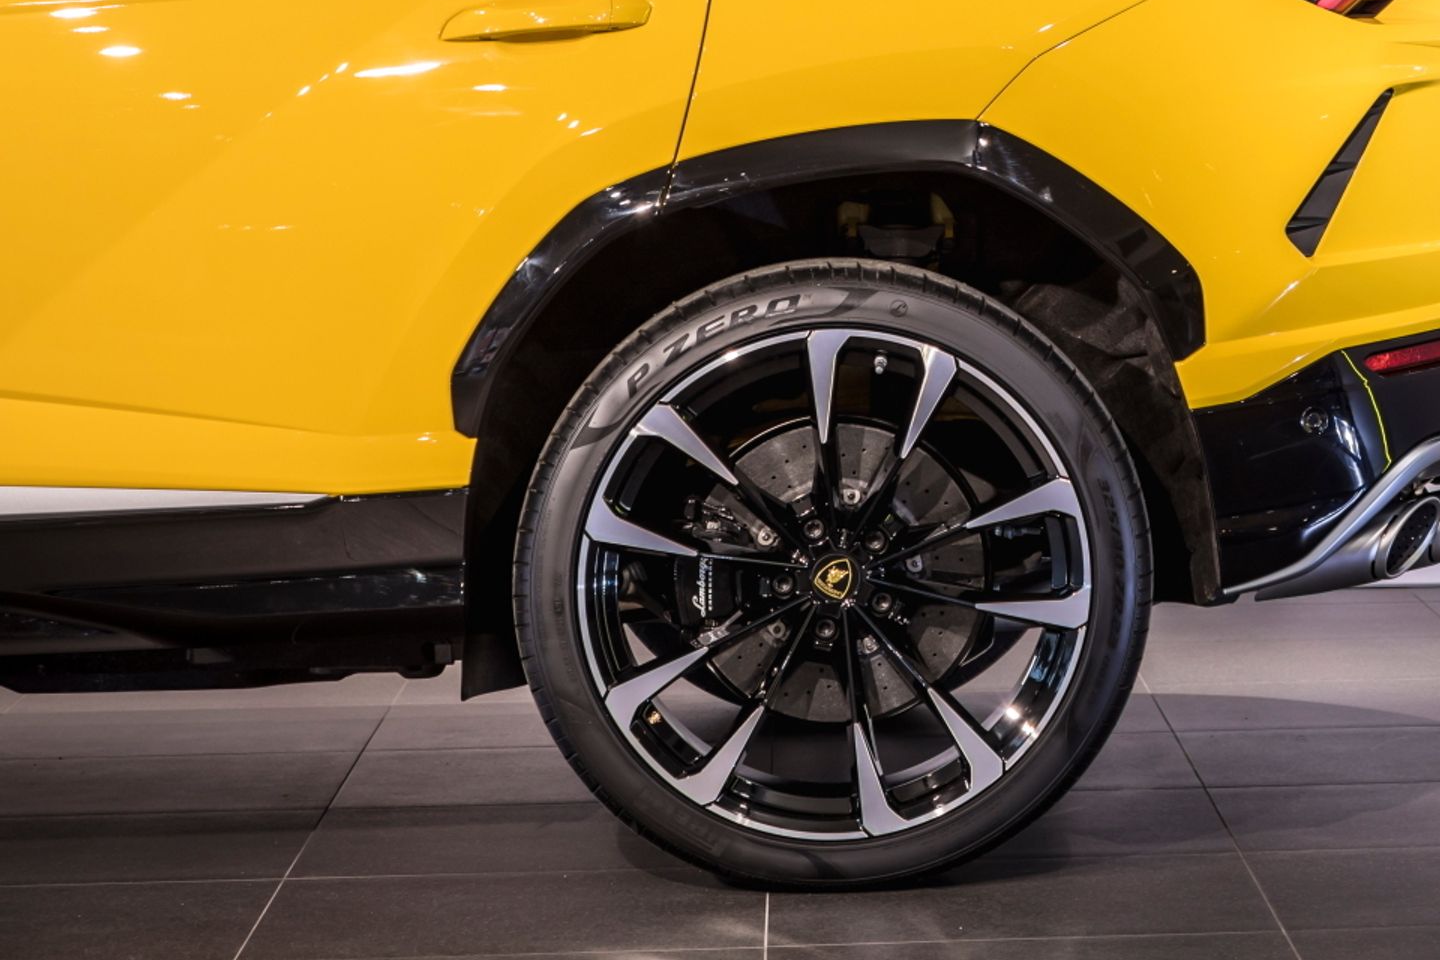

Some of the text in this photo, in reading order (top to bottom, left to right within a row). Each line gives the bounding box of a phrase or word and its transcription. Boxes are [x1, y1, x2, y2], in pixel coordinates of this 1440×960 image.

[627, 293, 801, 398] P ZERO
[691, 556, 709, 618] Lamborg
